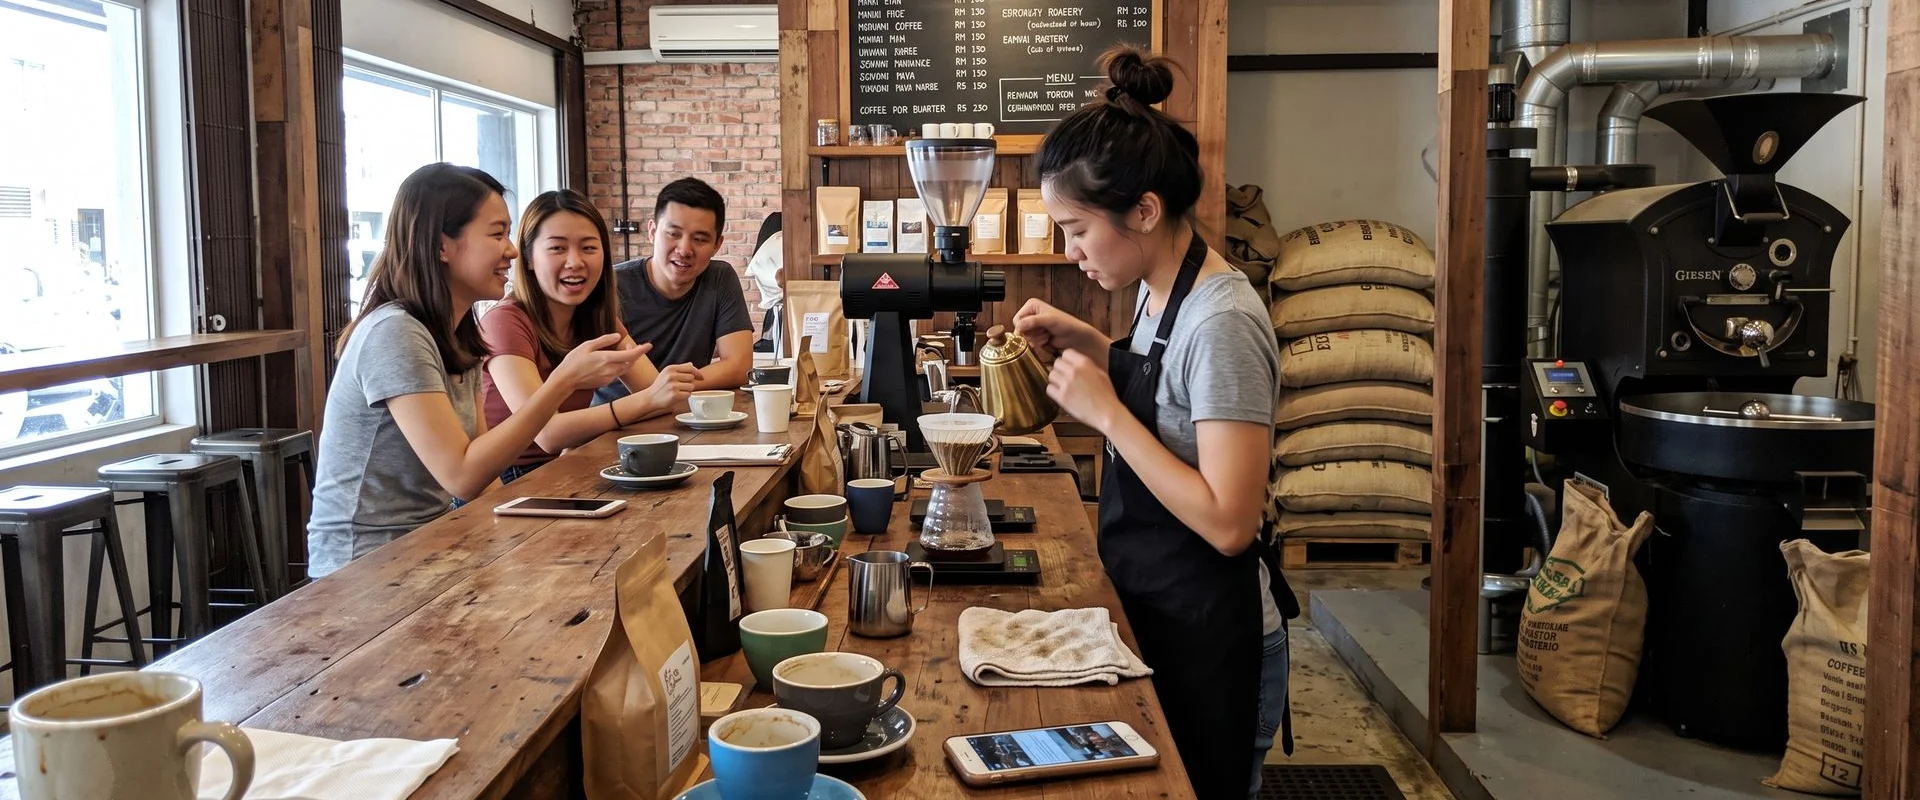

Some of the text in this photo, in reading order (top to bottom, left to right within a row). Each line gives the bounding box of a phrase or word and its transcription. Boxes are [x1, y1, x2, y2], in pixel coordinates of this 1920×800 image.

[954, 8, 966, 16] RM
[1117, 6, 1129, 15] RM
[895, 21, 923, 31] COFFEE
[954, 20, 966, 29] RM
[971, 20, 986, 29] 150
[955, 33, 966, 41] RM
[971, 33, 986, 41] 150
[955, 45, 966, 54] RM
[971, 45, 986, 54] 150
[955, 57, 967, 66] RM
[972, 57, 987, 66] 150
[955, 69, 967, 78] RM
[972, 69, 987, 78] 150
[1046, 73, 1075, 83] MENU
[973, 81, 987, 90] 150
[860, 105, 887, 115] COFFEE
[1675, 270, 1721, 281] GIESEN
[1829, 764, 1849, 781] 12
